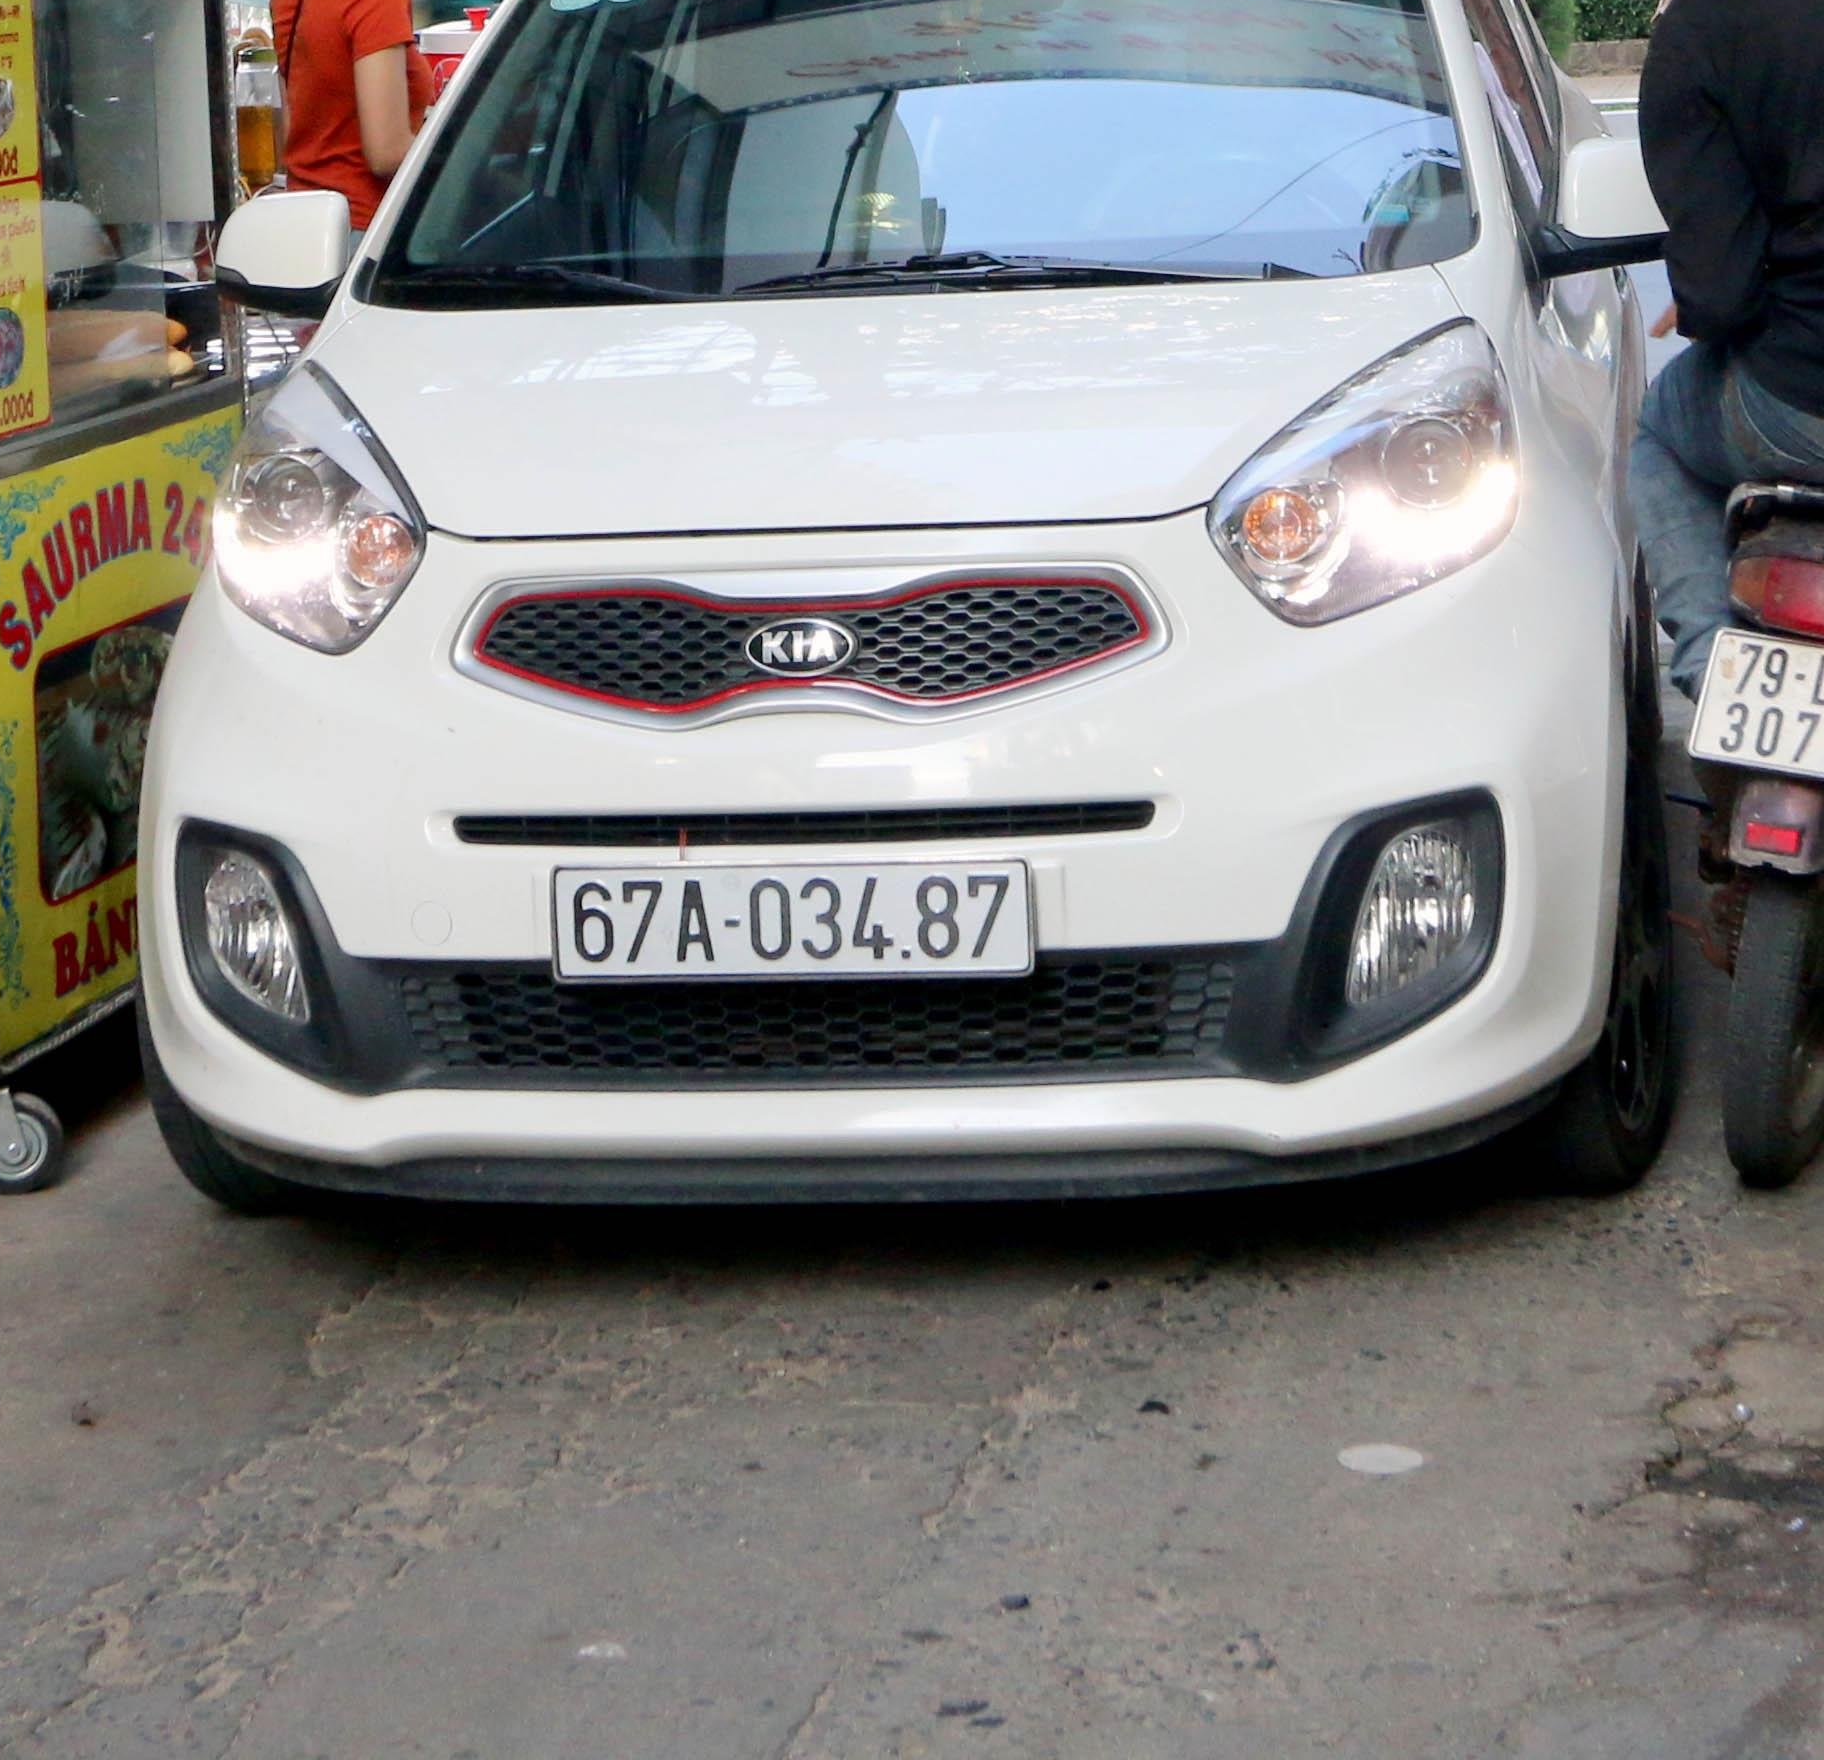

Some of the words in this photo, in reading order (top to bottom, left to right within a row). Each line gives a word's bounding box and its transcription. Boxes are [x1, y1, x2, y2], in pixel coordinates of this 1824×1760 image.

[162, 481, 212, 566] 24
[760, 630, 838, 663] KIA
[52, 900, 140, 998] BÁN
[572, 874, 1010, 964] 67A-034.87
